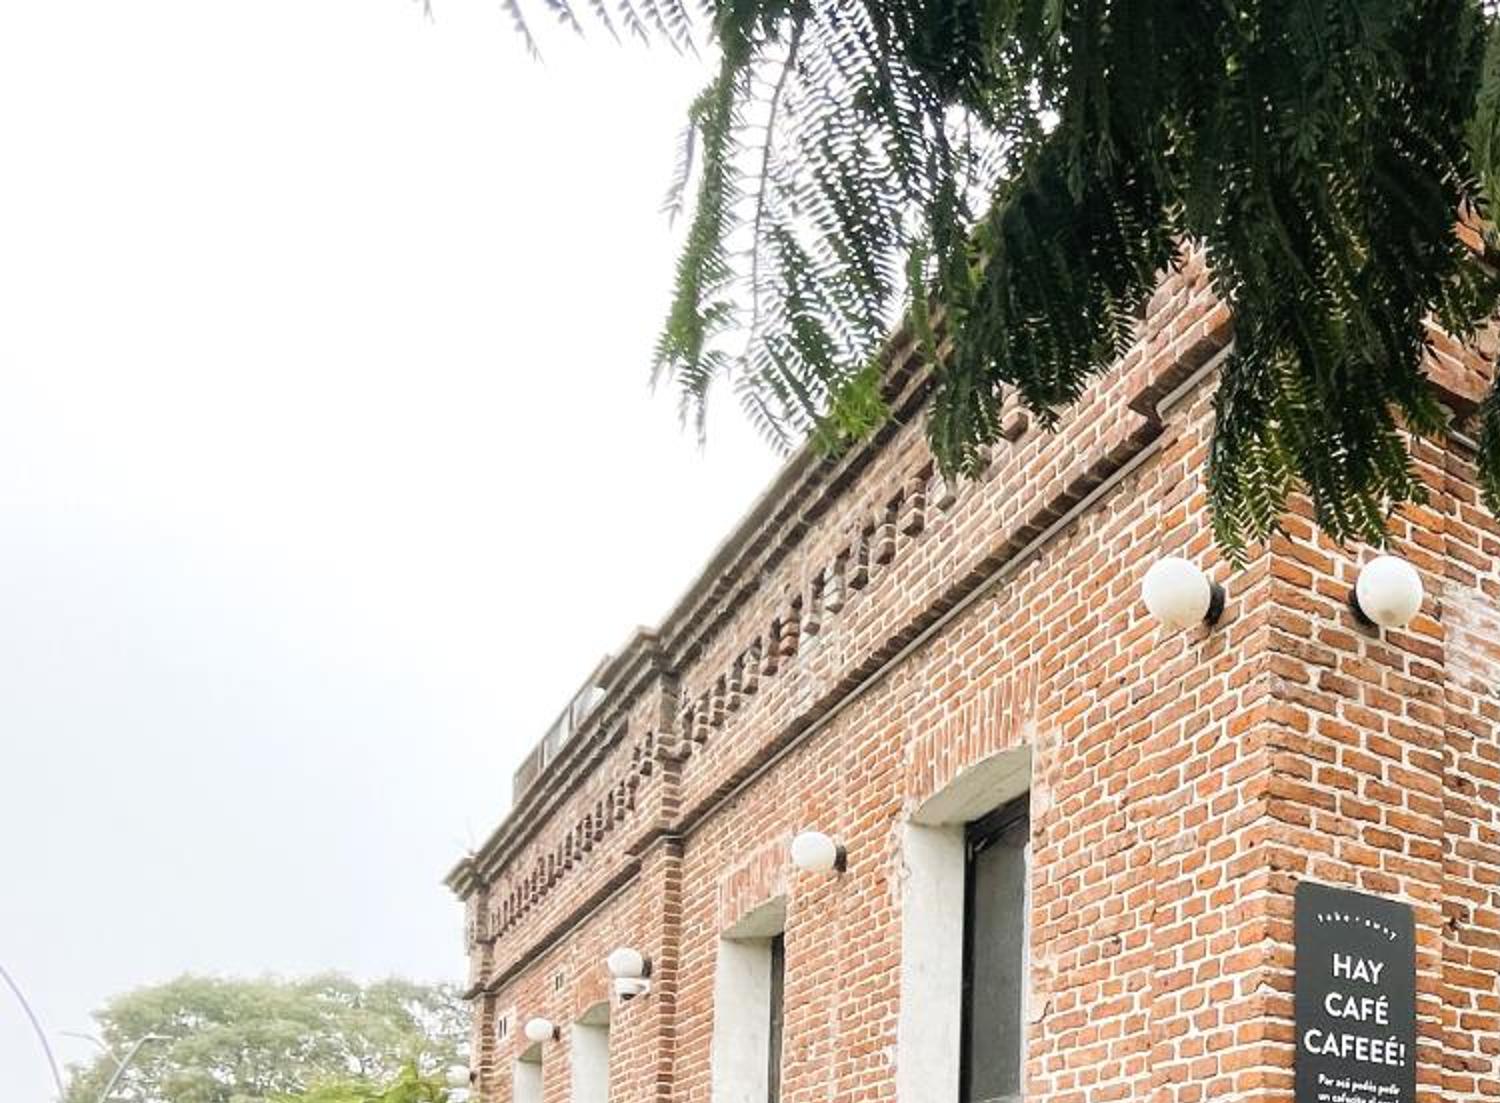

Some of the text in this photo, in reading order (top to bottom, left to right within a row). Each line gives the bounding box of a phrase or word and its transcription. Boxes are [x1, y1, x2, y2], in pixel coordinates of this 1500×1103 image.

[1333, 953, 1384, 984] HAY
[1325, 992, 1389, 1025] CAFÉ
[1304, 1028, 1405, 1066] CAFEEÉ!
